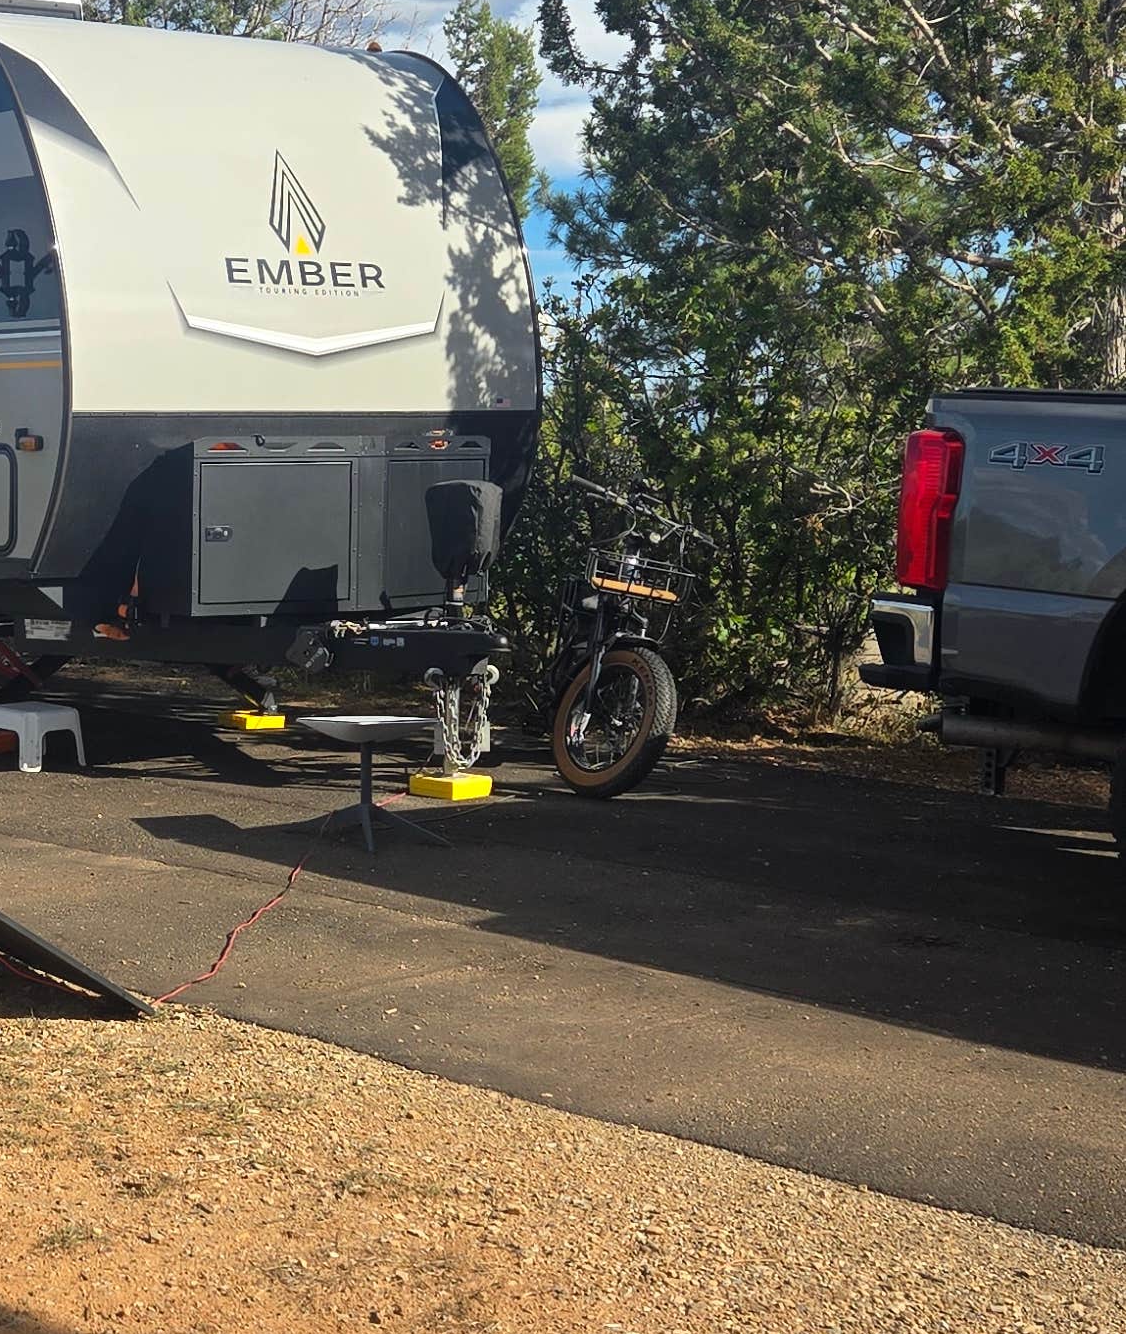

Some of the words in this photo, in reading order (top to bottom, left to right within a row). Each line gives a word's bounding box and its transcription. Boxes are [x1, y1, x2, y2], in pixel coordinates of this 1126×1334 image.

[225, 257, 385, 289] EMBER
[259, 286, 308, 295] TOURING
[315, 289, 360, 297] EDITION
